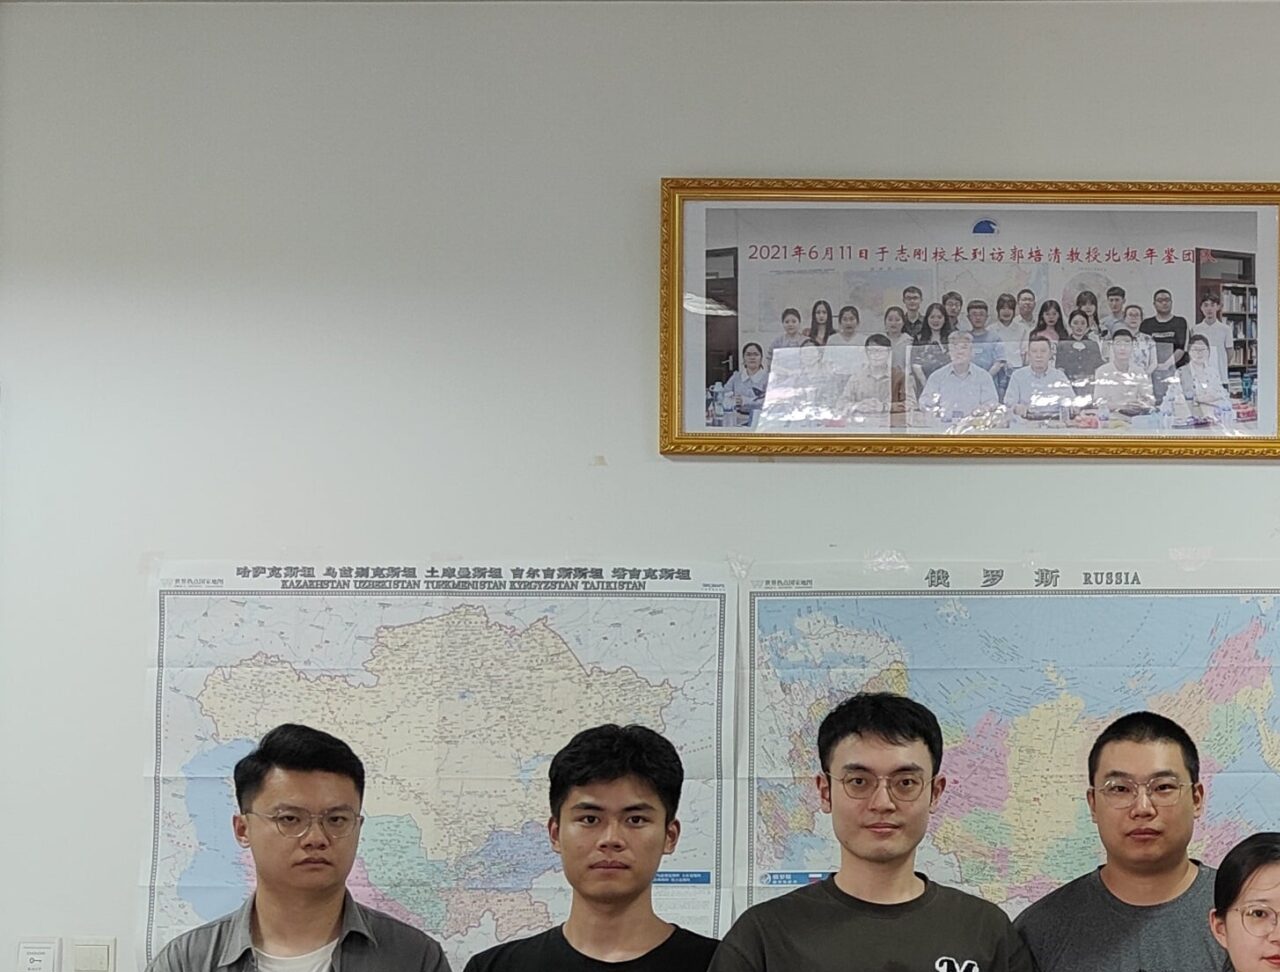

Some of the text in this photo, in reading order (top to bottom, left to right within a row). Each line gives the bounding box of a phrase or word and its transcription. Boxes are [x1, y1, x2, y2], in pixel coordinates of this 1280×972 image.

[236, 566, 315, 578] 哈萨克斯坦
[425, 567, 503, 579] 土库曼斯坦
[510, 567, 604, 580] 吉尔吉斯斯坦
[611, 567, 691, 580] 塔吉克斯坦
[924, 568, 1142, 588] 俄罗斯 RUSSIA
[280, 579, 350, 590] KAZAKHSTAN
[353, 579, 421, 590] UZBEKISTAN
[424, 580, 507, 590] TURKMENISTAN
[509, 580, 580, 591] KYRGYZSTAN
